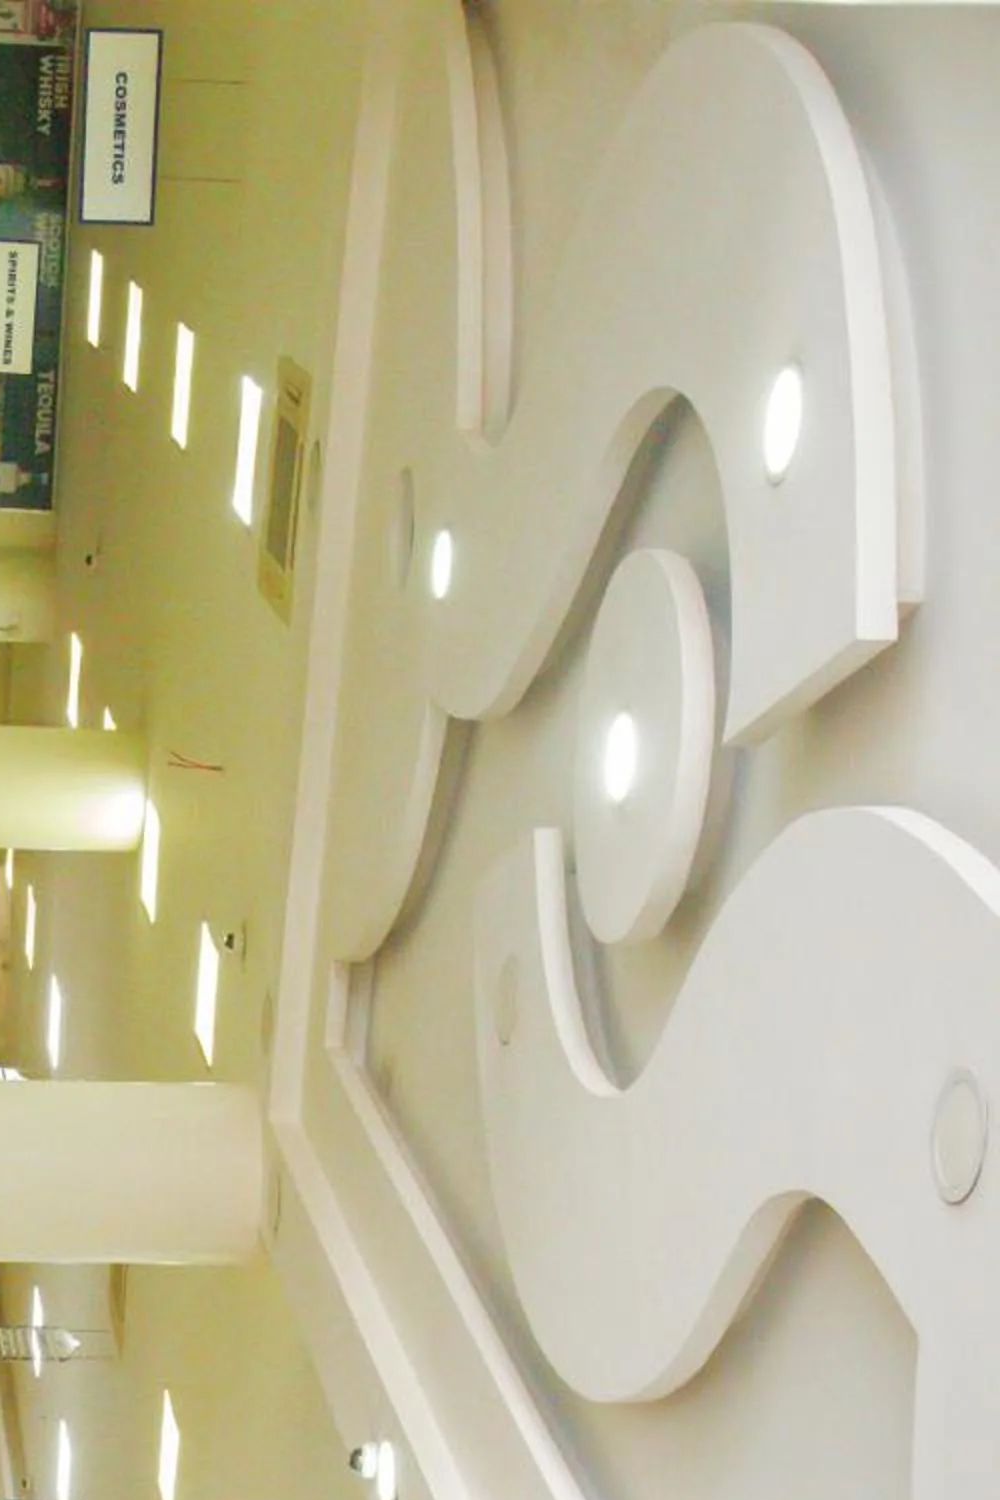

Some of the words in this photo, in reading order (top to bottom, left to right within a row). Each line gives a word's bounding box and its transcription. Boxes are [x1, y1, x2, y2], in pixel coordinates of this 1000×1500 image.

[36, 54, 54, 136] WHISKY
[54, 55, 72, 109] IRISH
[111, 71, 129, 186] COSMETICS
[6, 250, 18, 304] SPIRITS
[5, 308, 15, 318] &
[3, 322, 13, 365] WINES
[34, 370, 56, 455] TEQUILA
